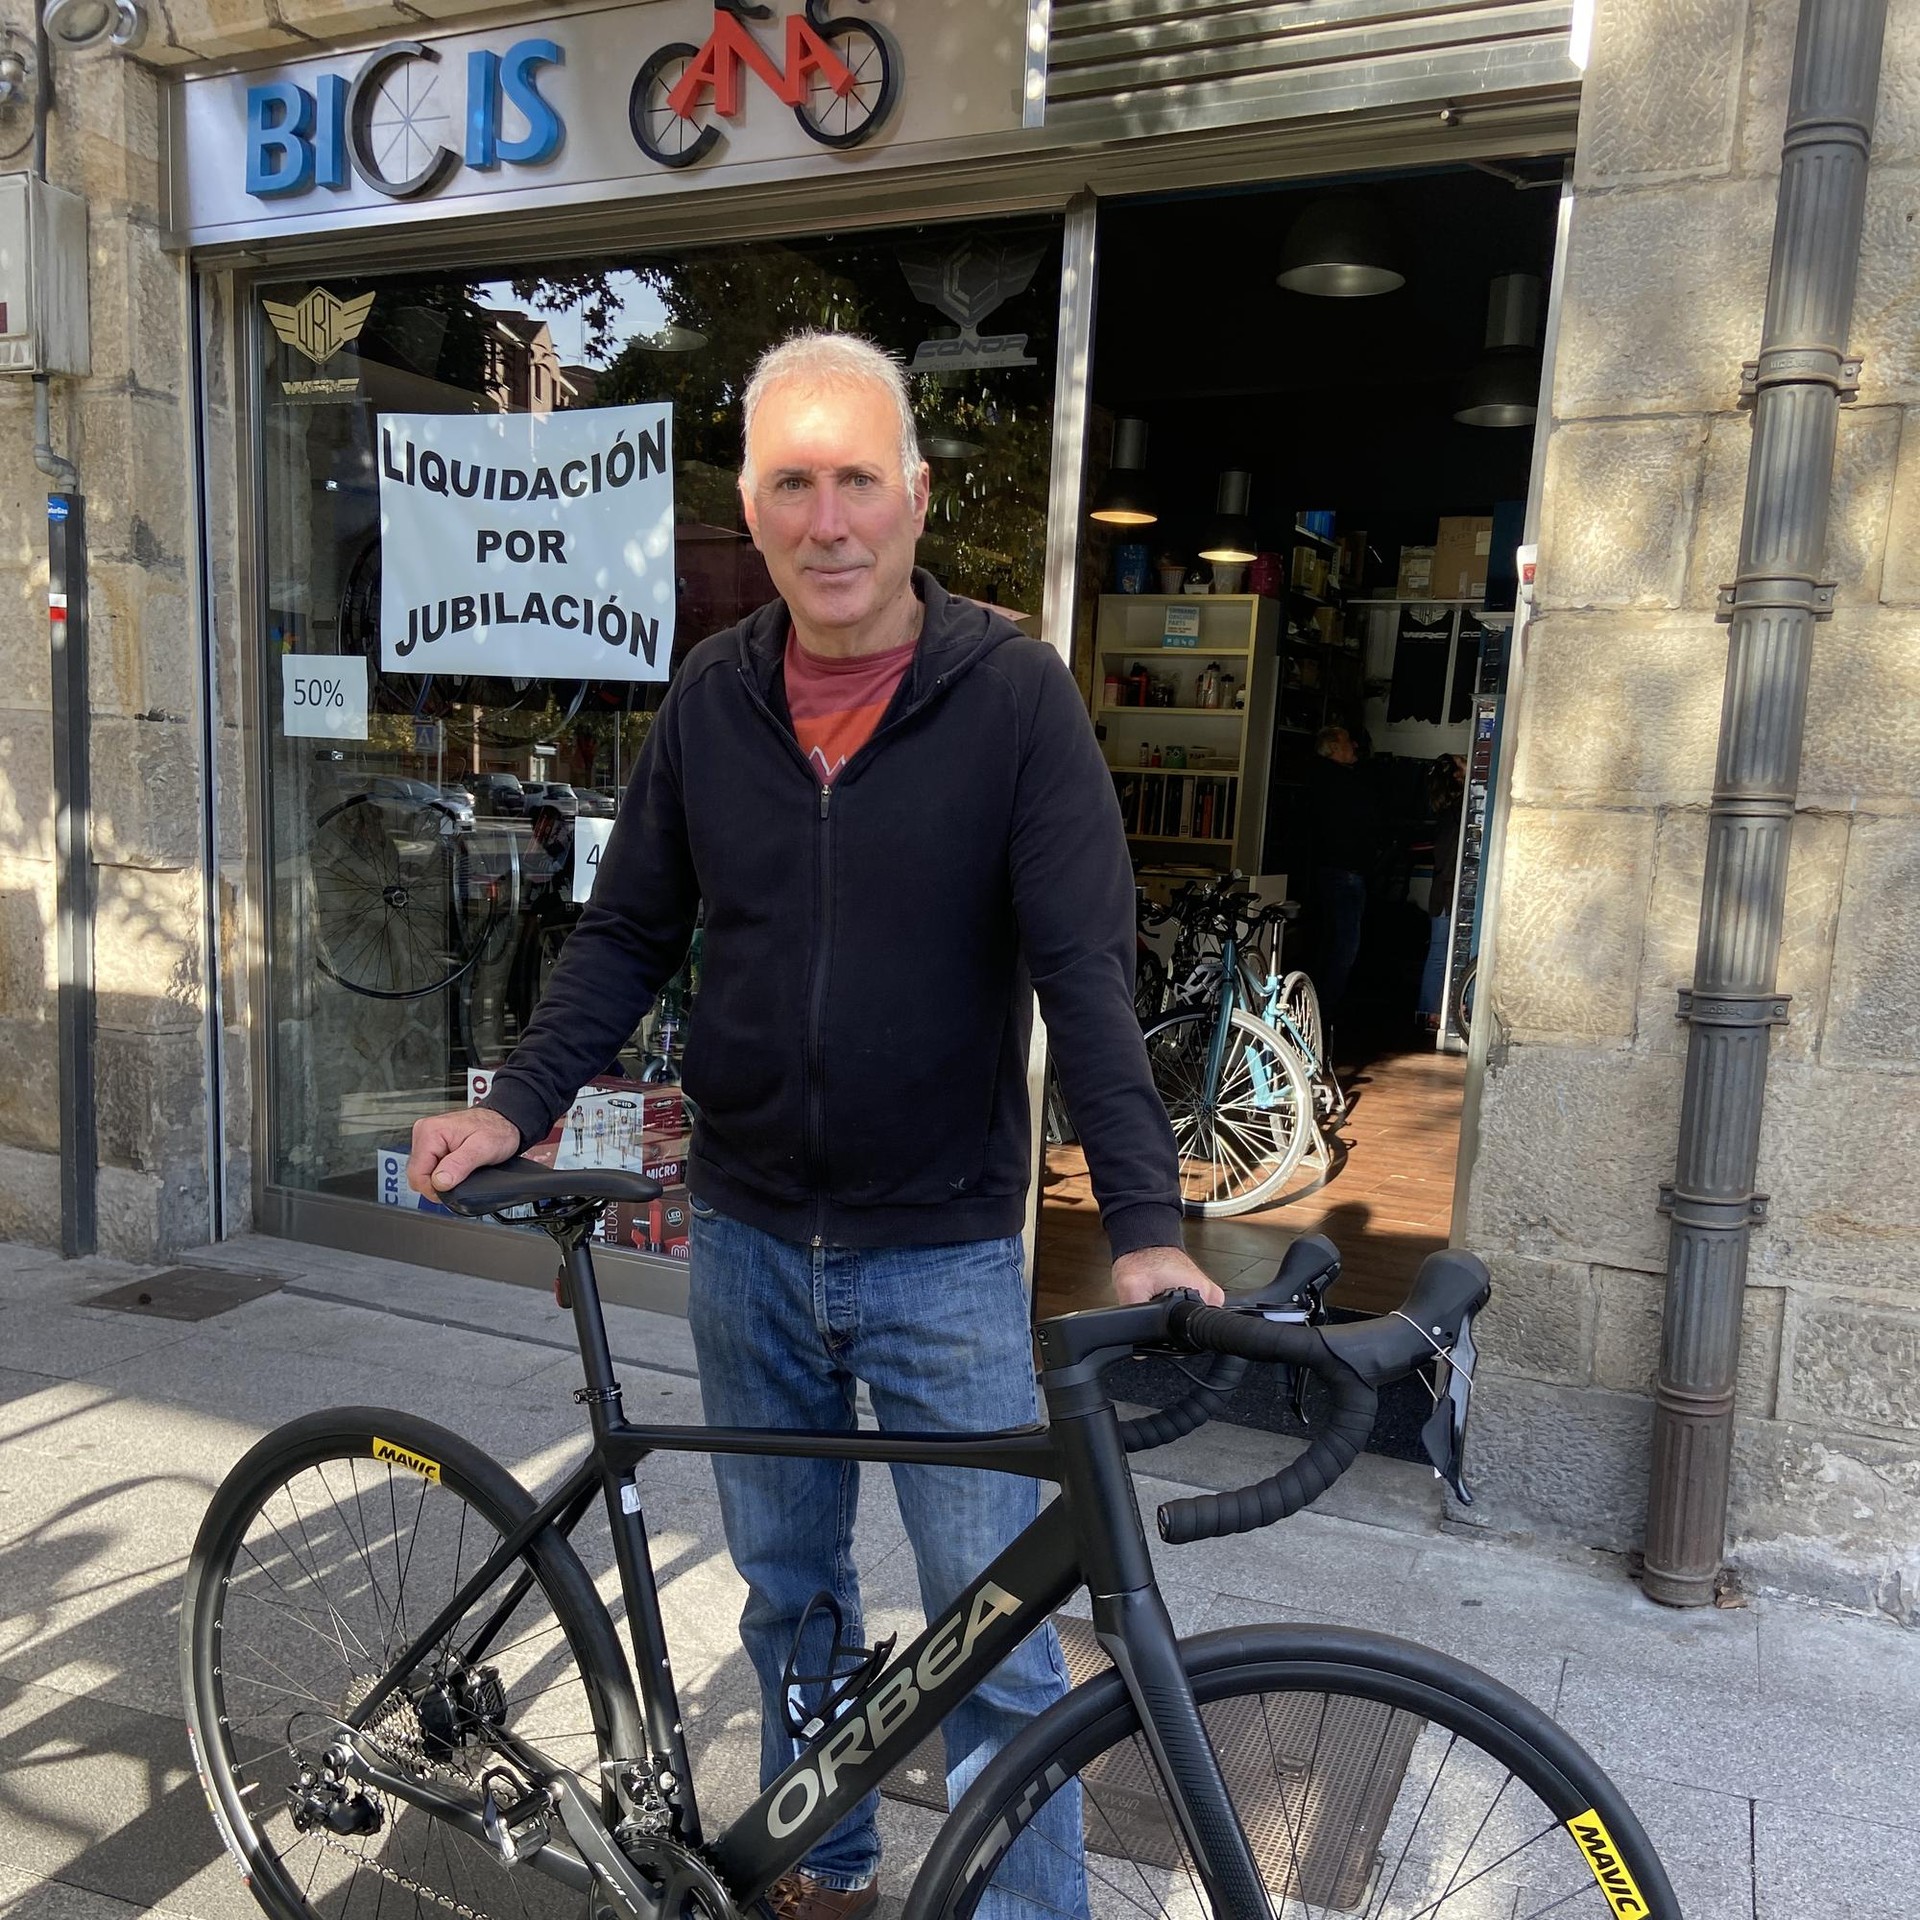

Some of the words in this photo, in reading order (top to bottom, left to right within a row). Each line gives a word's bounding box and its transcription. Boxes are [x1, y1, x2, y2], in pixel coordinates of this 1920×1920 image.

[246, 38, 567, 198] BICIS
[916, 335, 1027, 357] CONOR
[382, 418, 666, 501] LIQUIDACIÓN
[476, 530, 567, 564] POR
[395, 592, 659, 668] JUBILACIÓN
[293, 679, 344, 707] 50%
[646, 1163, 677, 1180] MICRO
[607, 1202, 618, 1244] ELUXE
[378, 1445, 437, 1479] MAVIC
[767, 1580, 1024, 1839] ORBEA
[1574, 1824, 1642, 1913] MAVIC
